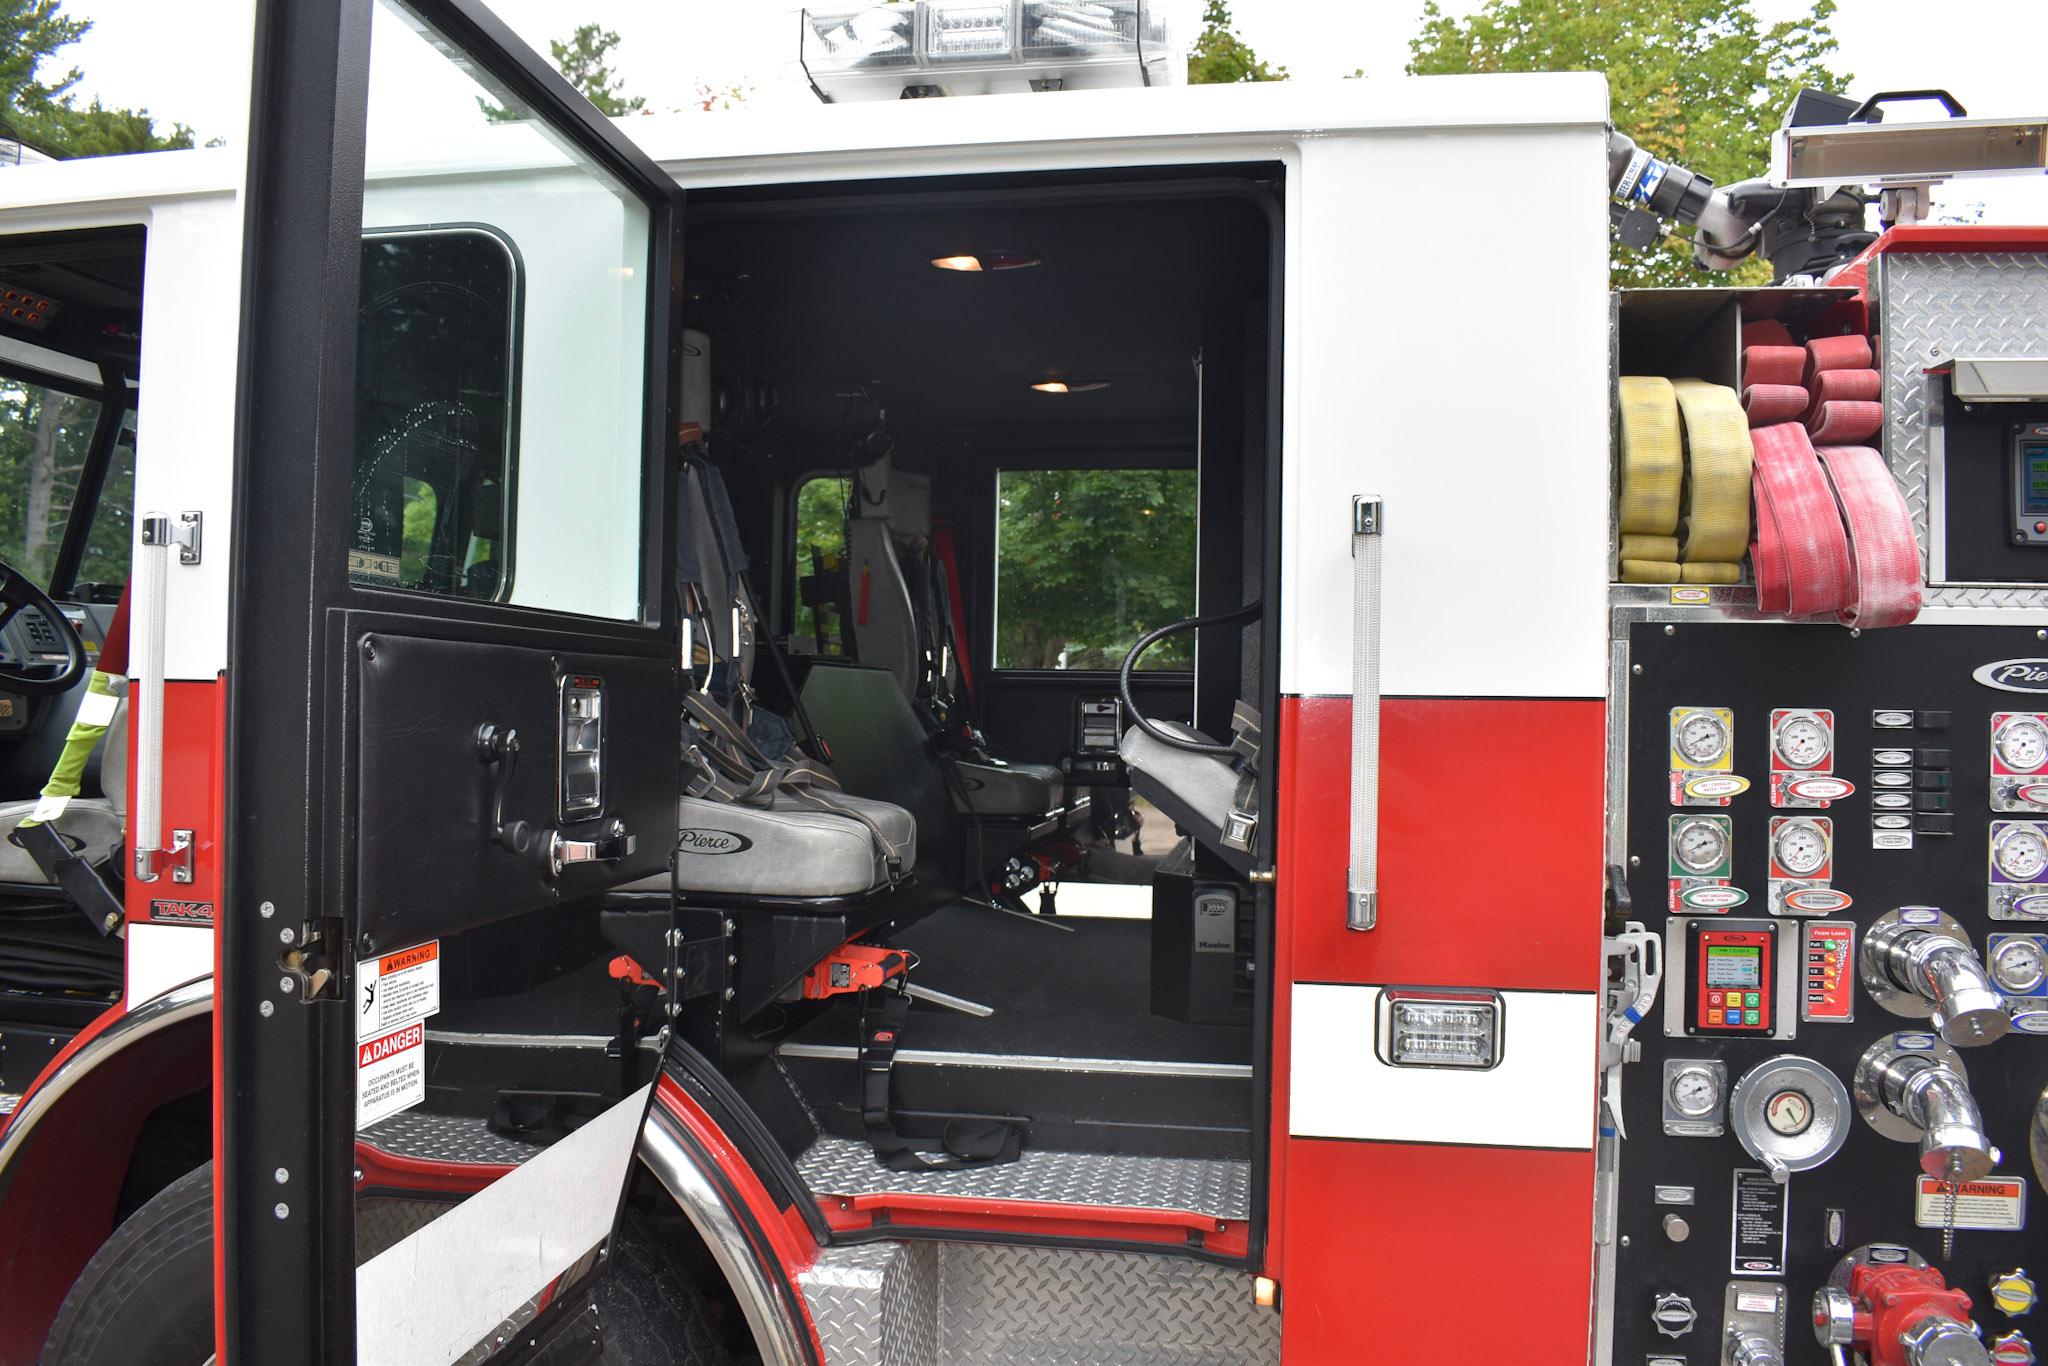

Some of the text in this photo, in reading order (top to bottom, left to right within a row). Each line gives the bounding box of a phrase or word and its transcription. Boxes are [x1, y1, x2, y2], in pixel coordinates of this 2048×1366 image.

[679, 831, 730, 849] Pierce
[392, 949, 431, 968] WARNING
[373, 1027, 420, 1060] DANGER
[1948, 1184, 2005, 1195] ARNING
